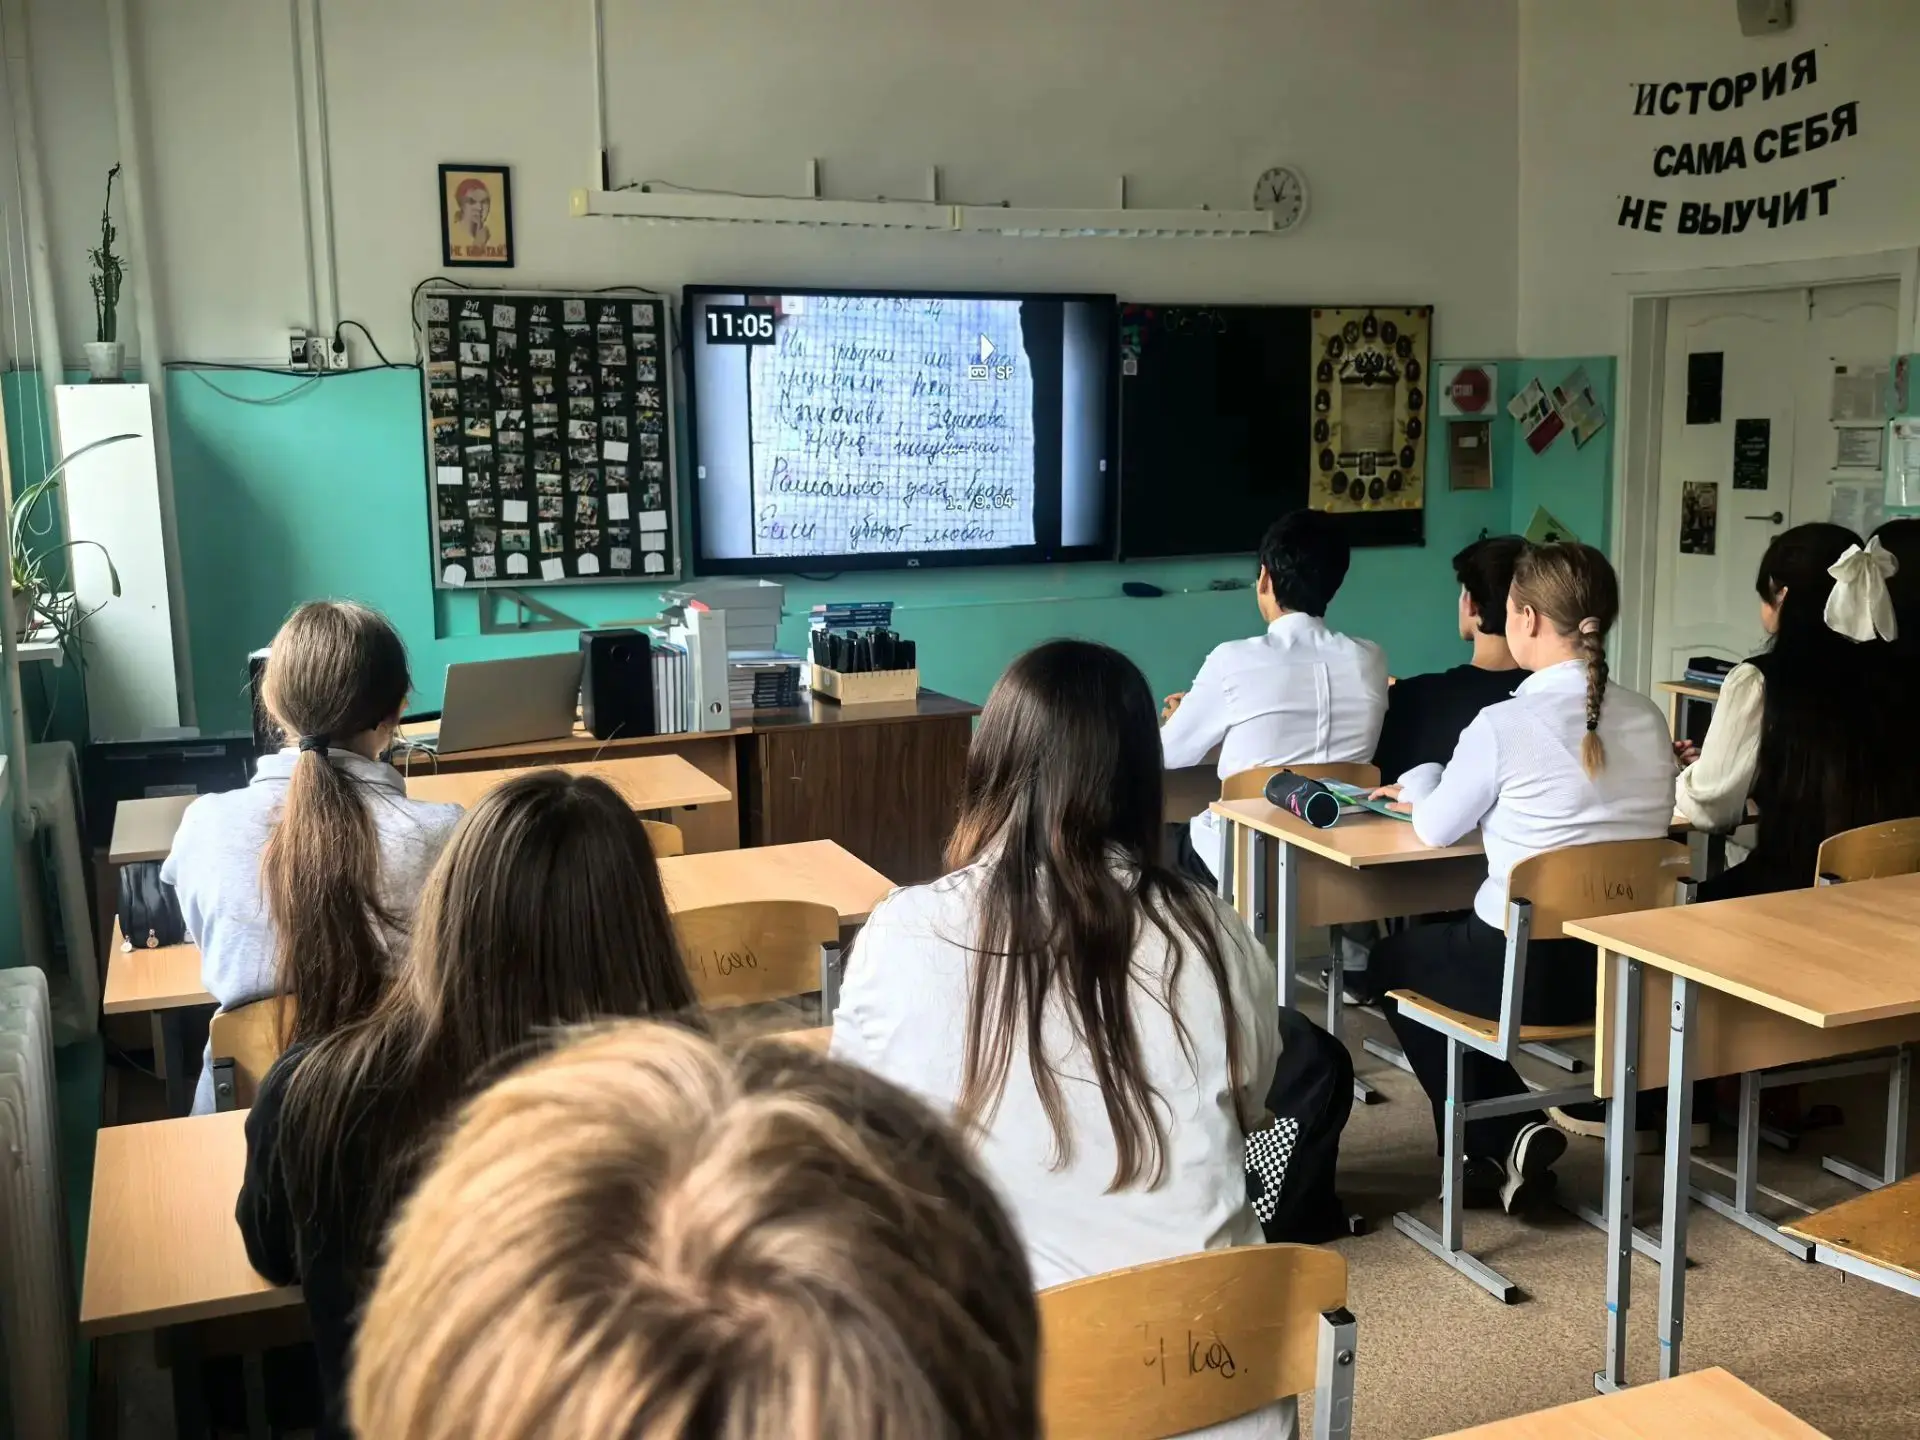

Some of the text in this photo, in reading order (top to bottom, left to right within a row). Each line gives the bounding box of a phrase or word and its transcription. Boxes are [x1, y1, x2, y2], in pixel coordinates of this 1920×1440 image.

[1633, 49, 1817, 116] ИСТОРИЯ
[1653, 101, 1859, 178] САМА СЕБЯ
[1617, 179, 1838, 235] НЕ ВЫУЧИТ
[707, 313, 773, 338] 11:05
[996, 365, 1015, 380] SP
